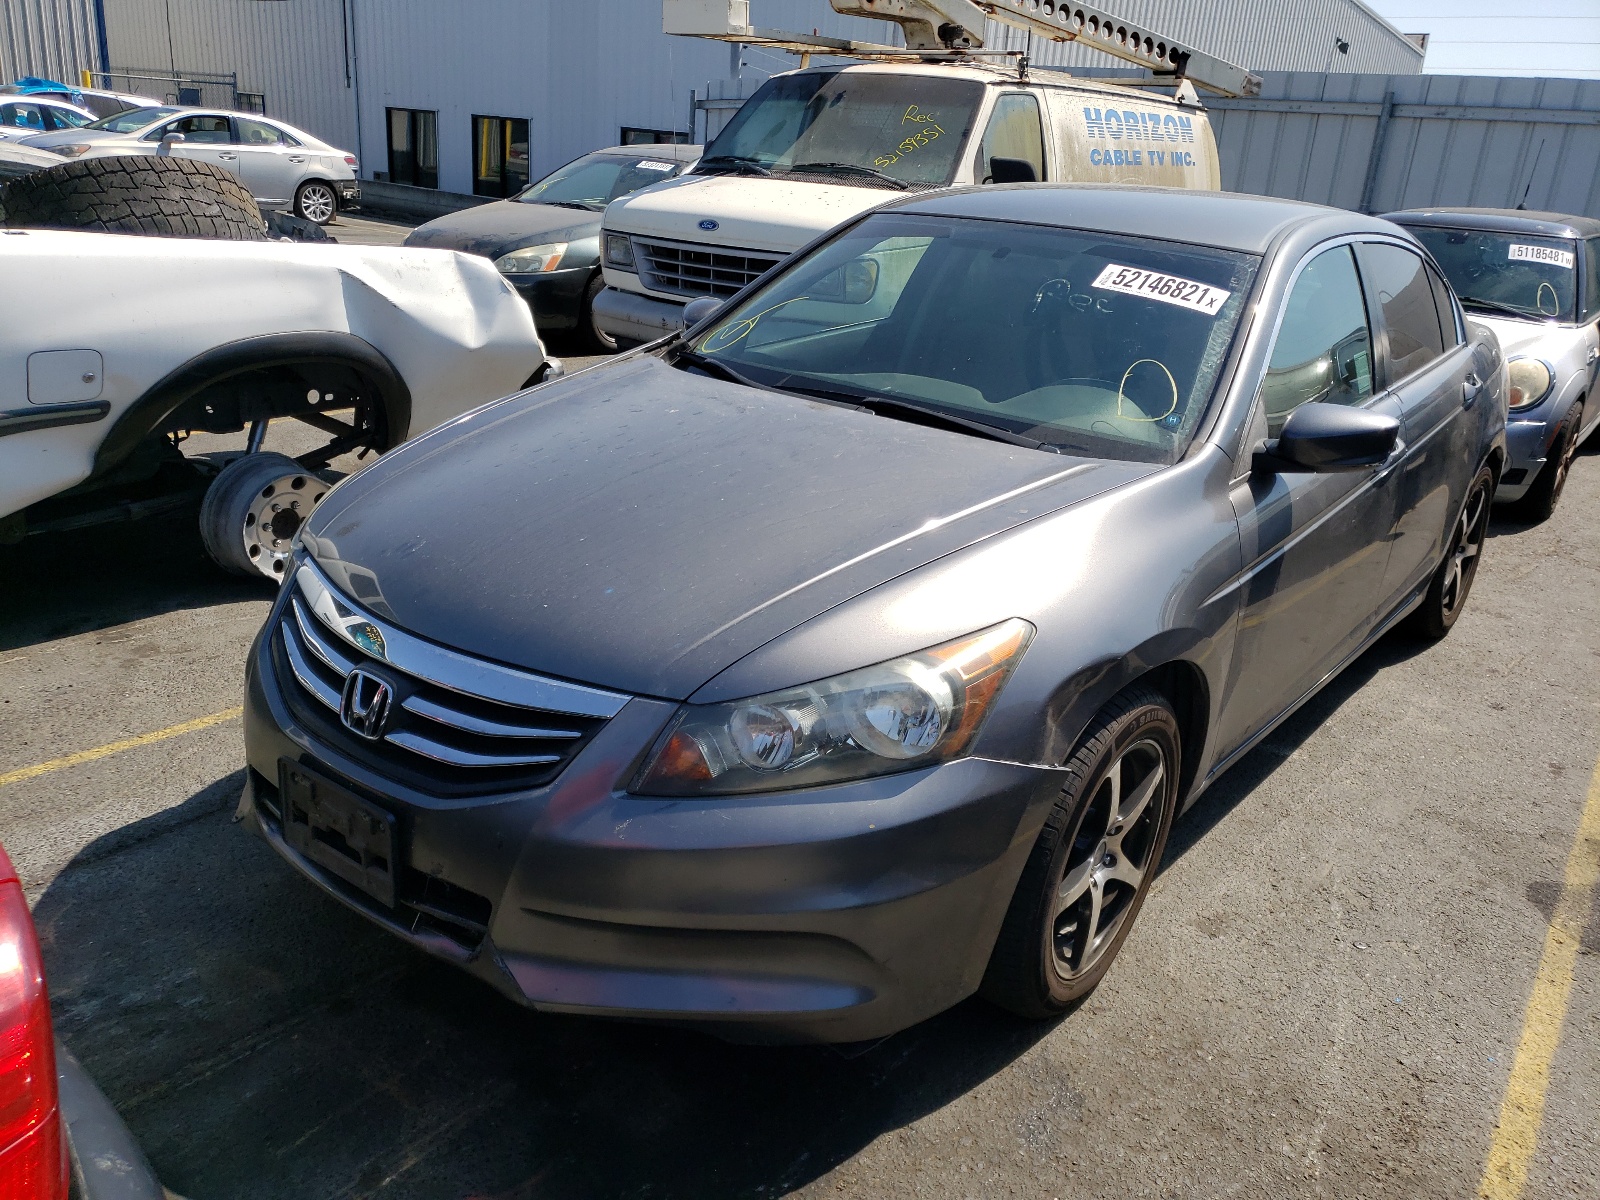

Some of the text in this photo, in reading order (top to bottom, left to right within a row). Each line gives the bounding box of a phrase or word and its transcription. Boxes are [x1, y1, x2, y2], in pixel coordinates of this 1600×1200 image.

[1083, 107, 1194, 143] HORIZON
[1090, 148, 1196, 166] CABLE TV INC.
